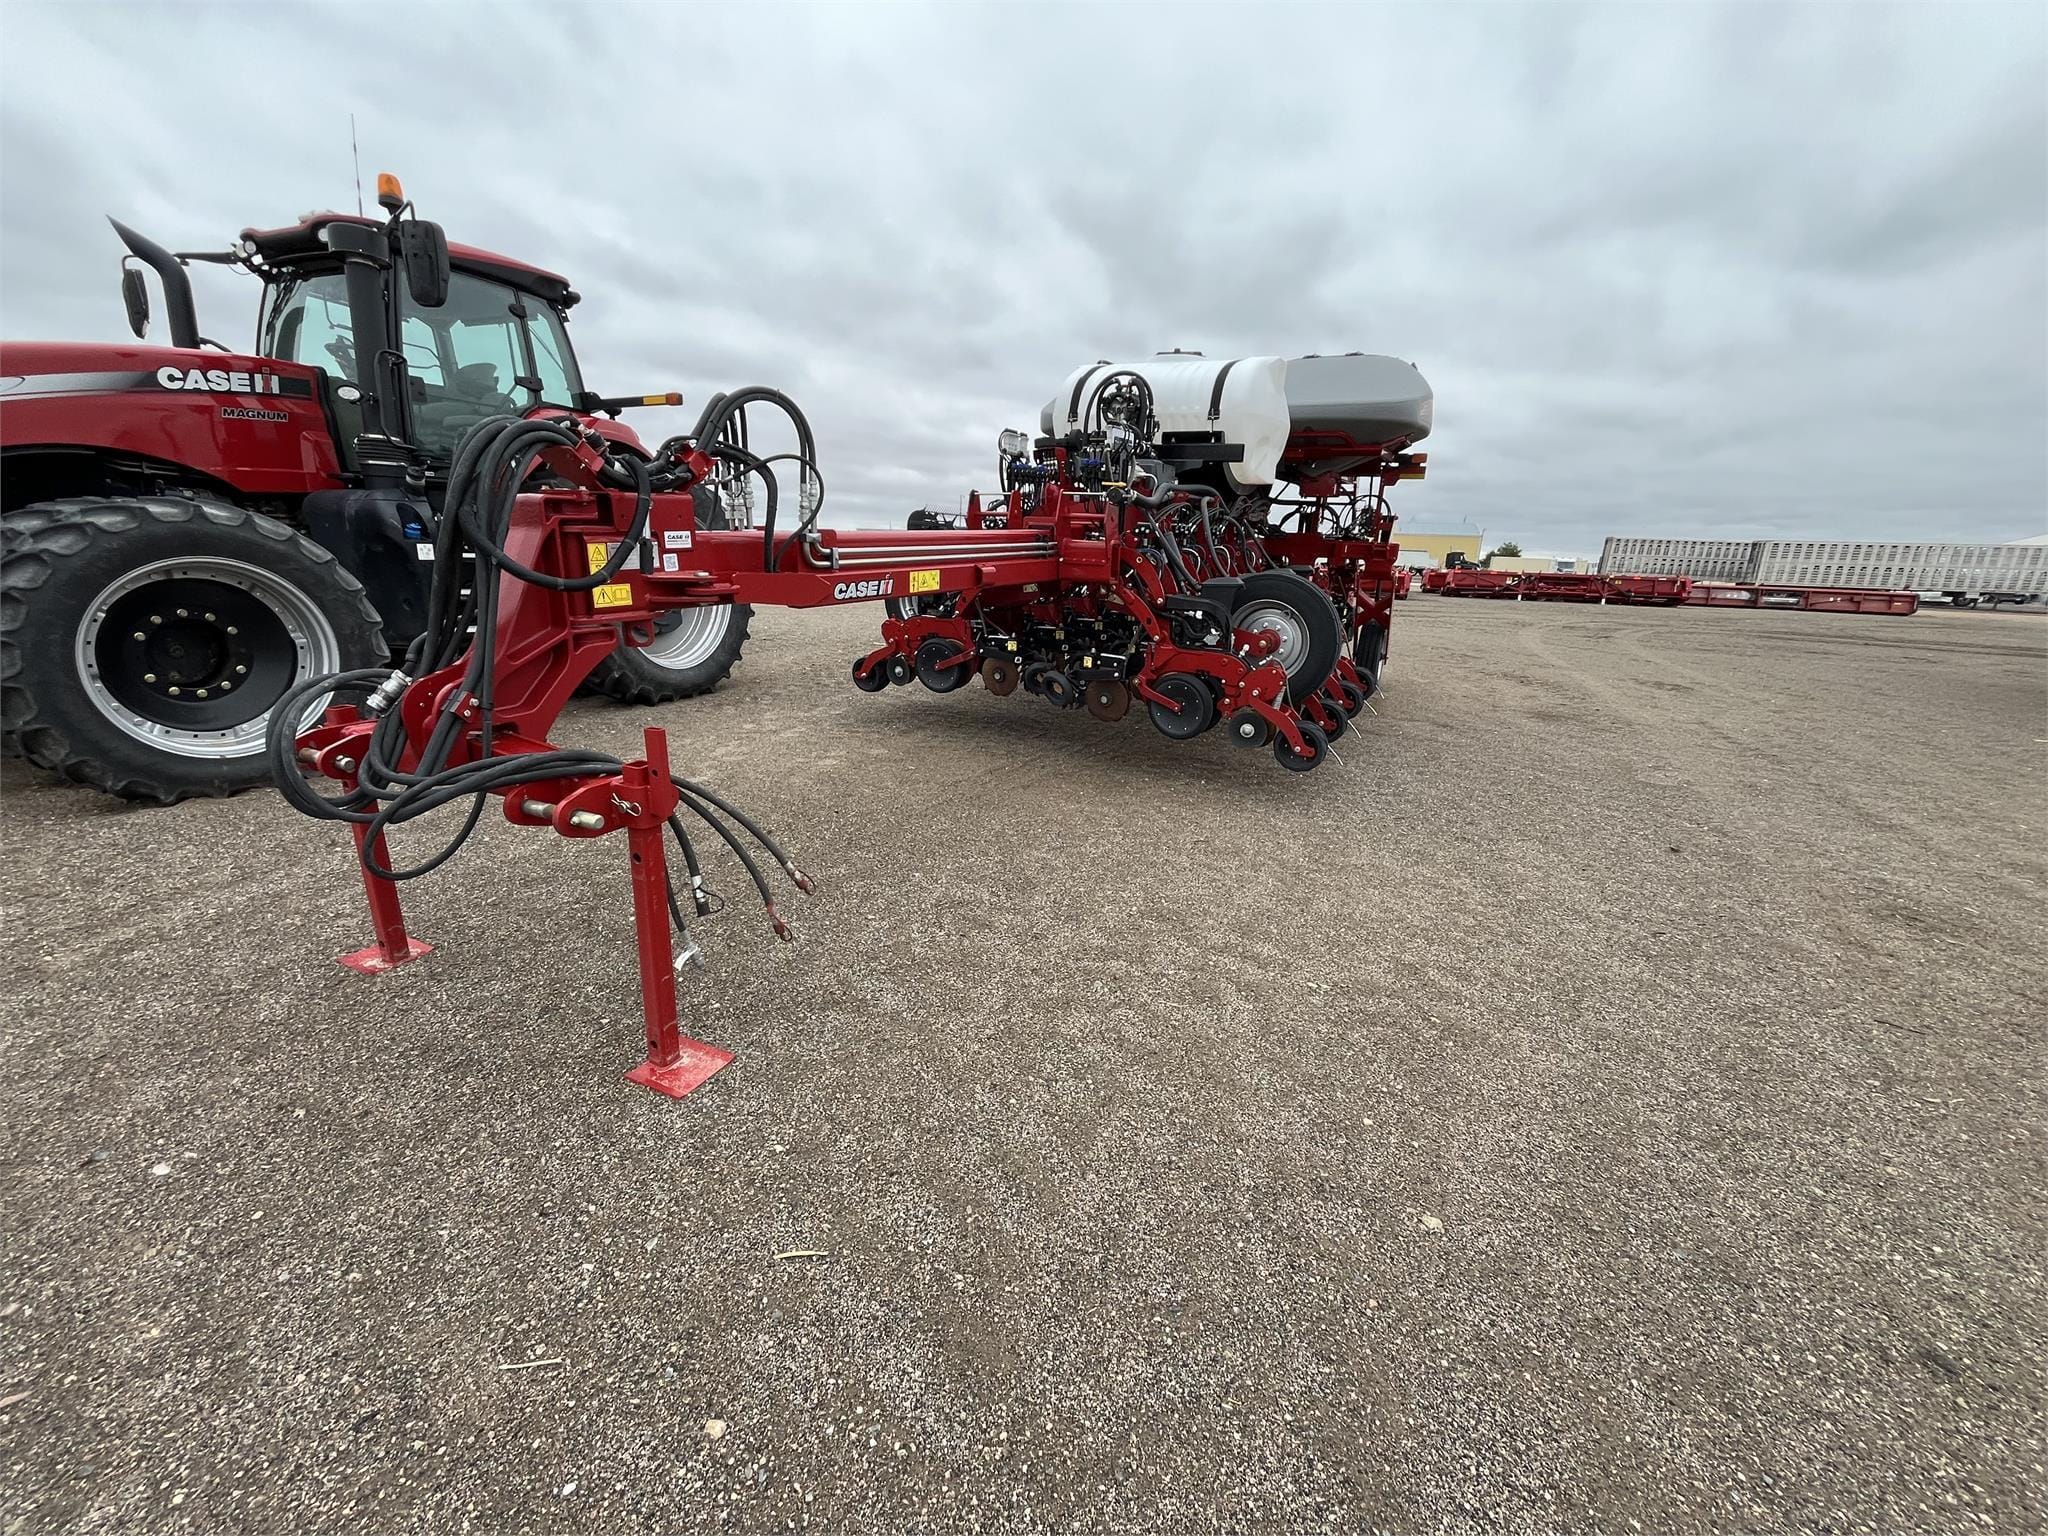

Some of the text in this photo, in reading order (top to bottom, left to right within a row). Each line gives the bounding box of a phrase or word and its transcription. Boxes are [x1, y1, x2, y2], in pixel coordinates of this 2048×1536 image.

[157, 366, 251, 393] CASE
[222, 407, 288, 422] MAGNUM
[834, 580, 879, 600] CASE
